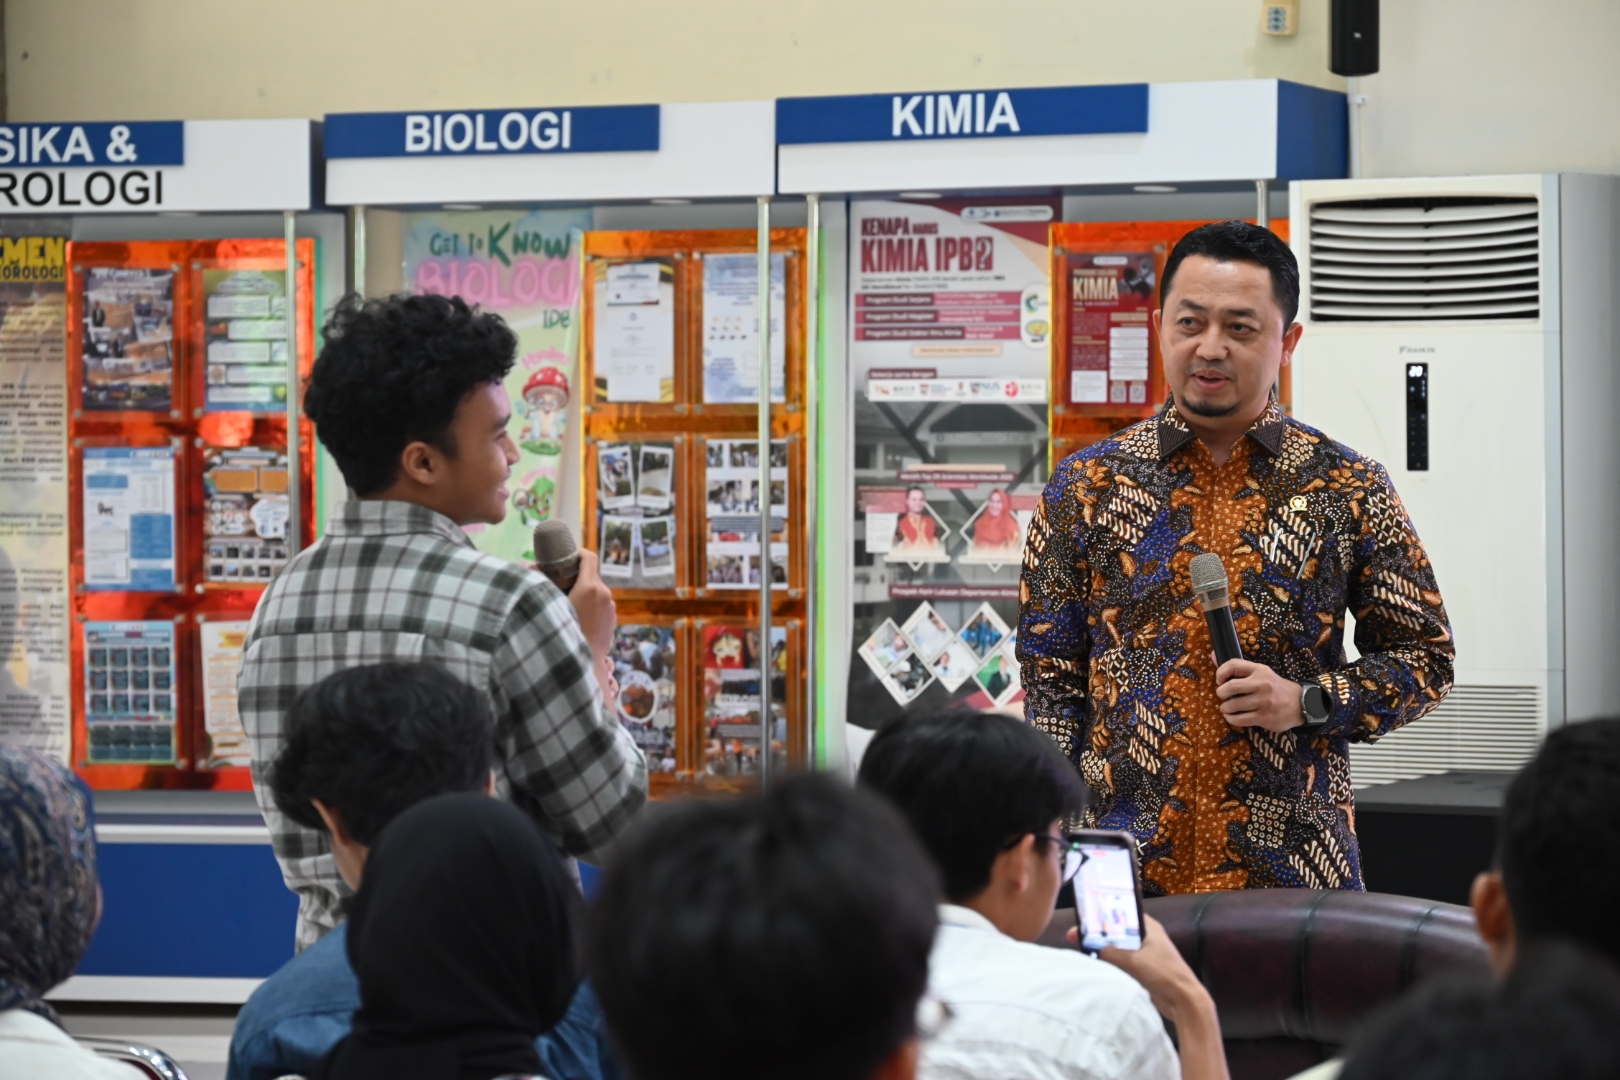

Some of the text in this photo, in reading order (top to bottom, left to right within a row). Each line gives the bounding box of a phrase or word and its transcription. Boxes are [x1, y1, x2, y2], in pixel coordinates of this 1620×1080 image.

[405, 111, 571, 152] BIOLOGI
[892, 92, 1020, 136] KIMIA
[106, 125, 137, 163] &
[489, 222, 571, 267] KNOW
[861, 217, 909, 236] KENAPA
[861, 237, 928, 273] KIMIA
[415, 257, 580, 308] BIOLOGI
[1073, 277, 1119, 300] KIMIA
